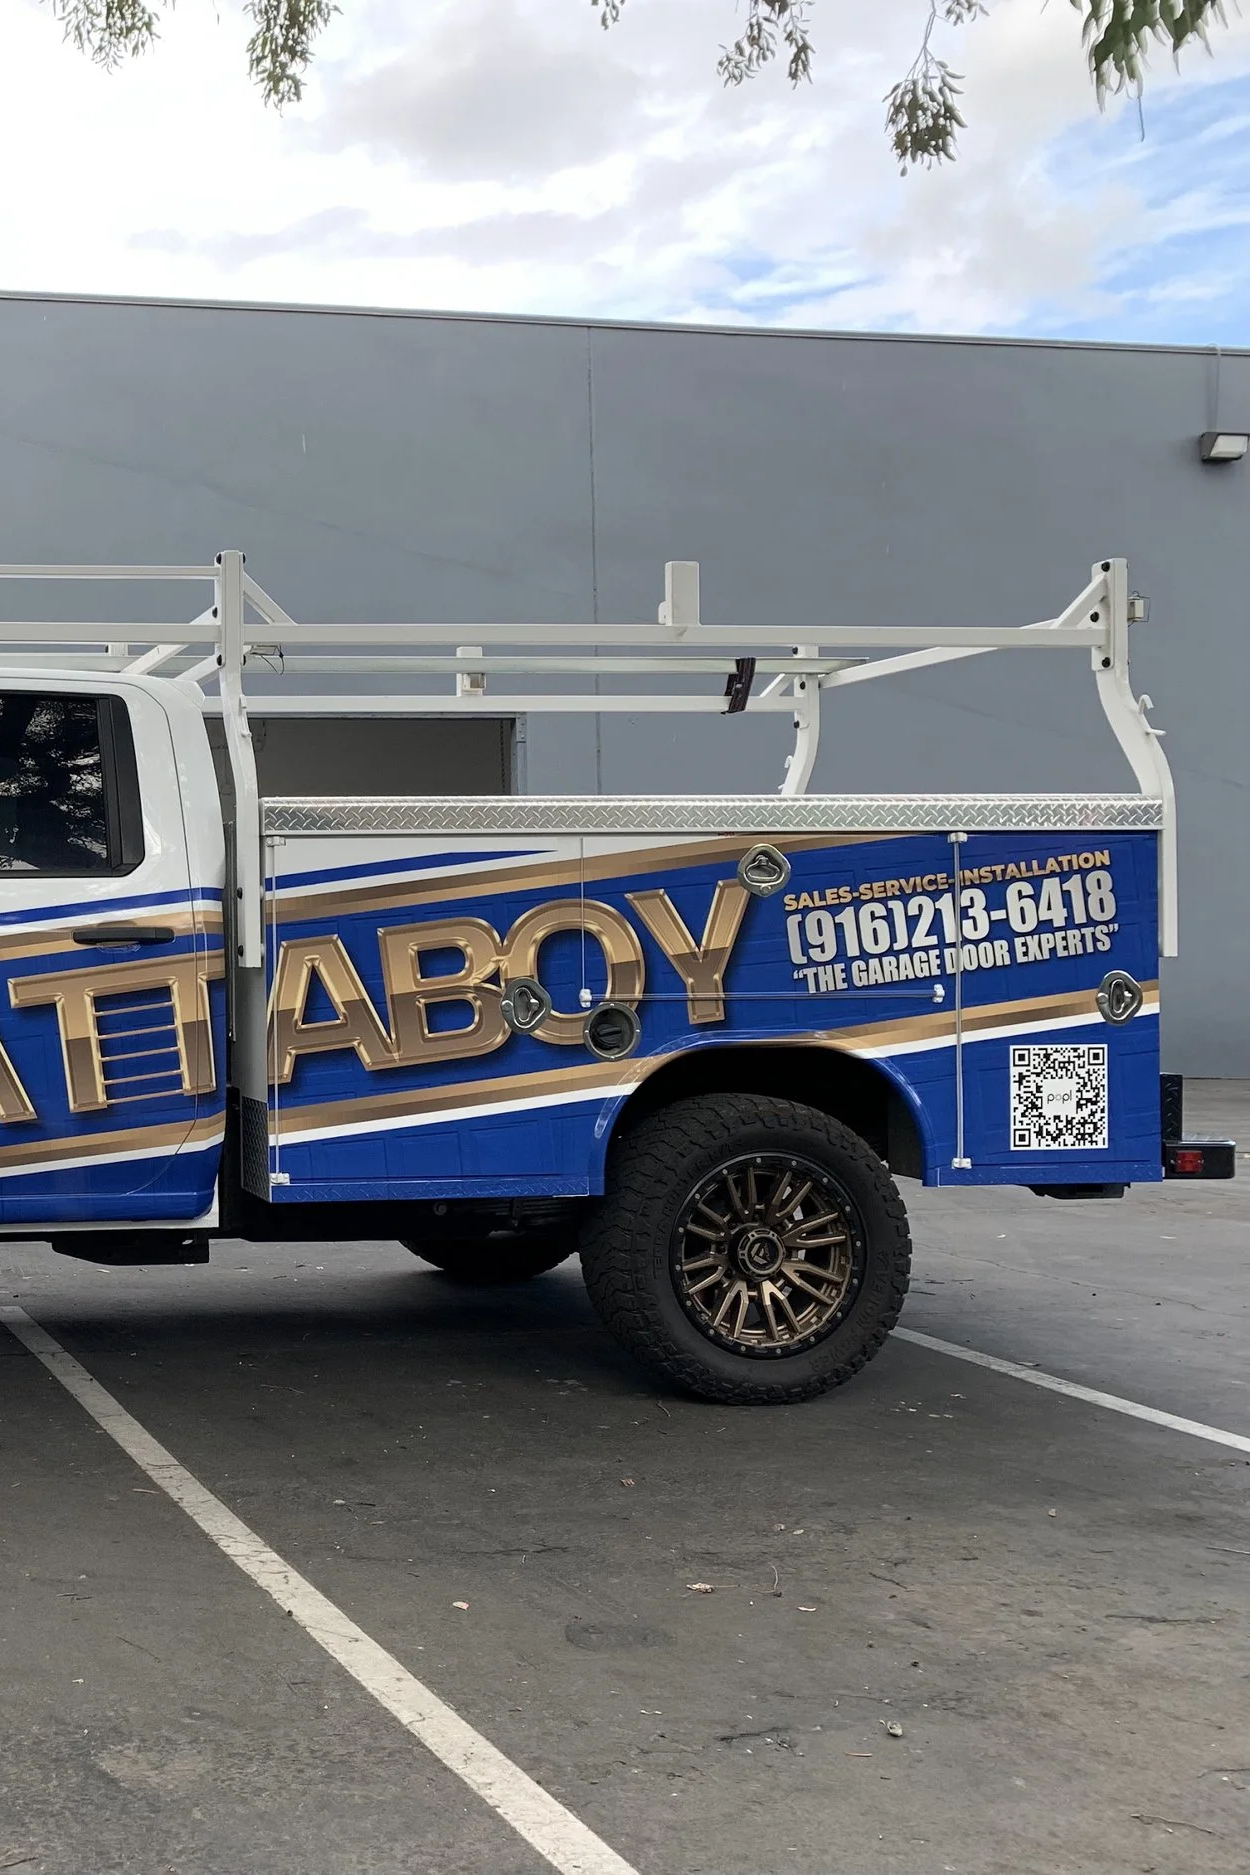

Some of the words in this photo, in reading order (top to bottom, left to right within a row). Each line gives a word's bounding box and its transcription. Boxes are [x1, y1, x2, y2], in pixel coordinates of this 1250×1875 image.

[851, 952, 942, 988] GARAGE
[943, 938, 1011, 976] DOOR
[1047, 1089, 1073, 1104] popl
